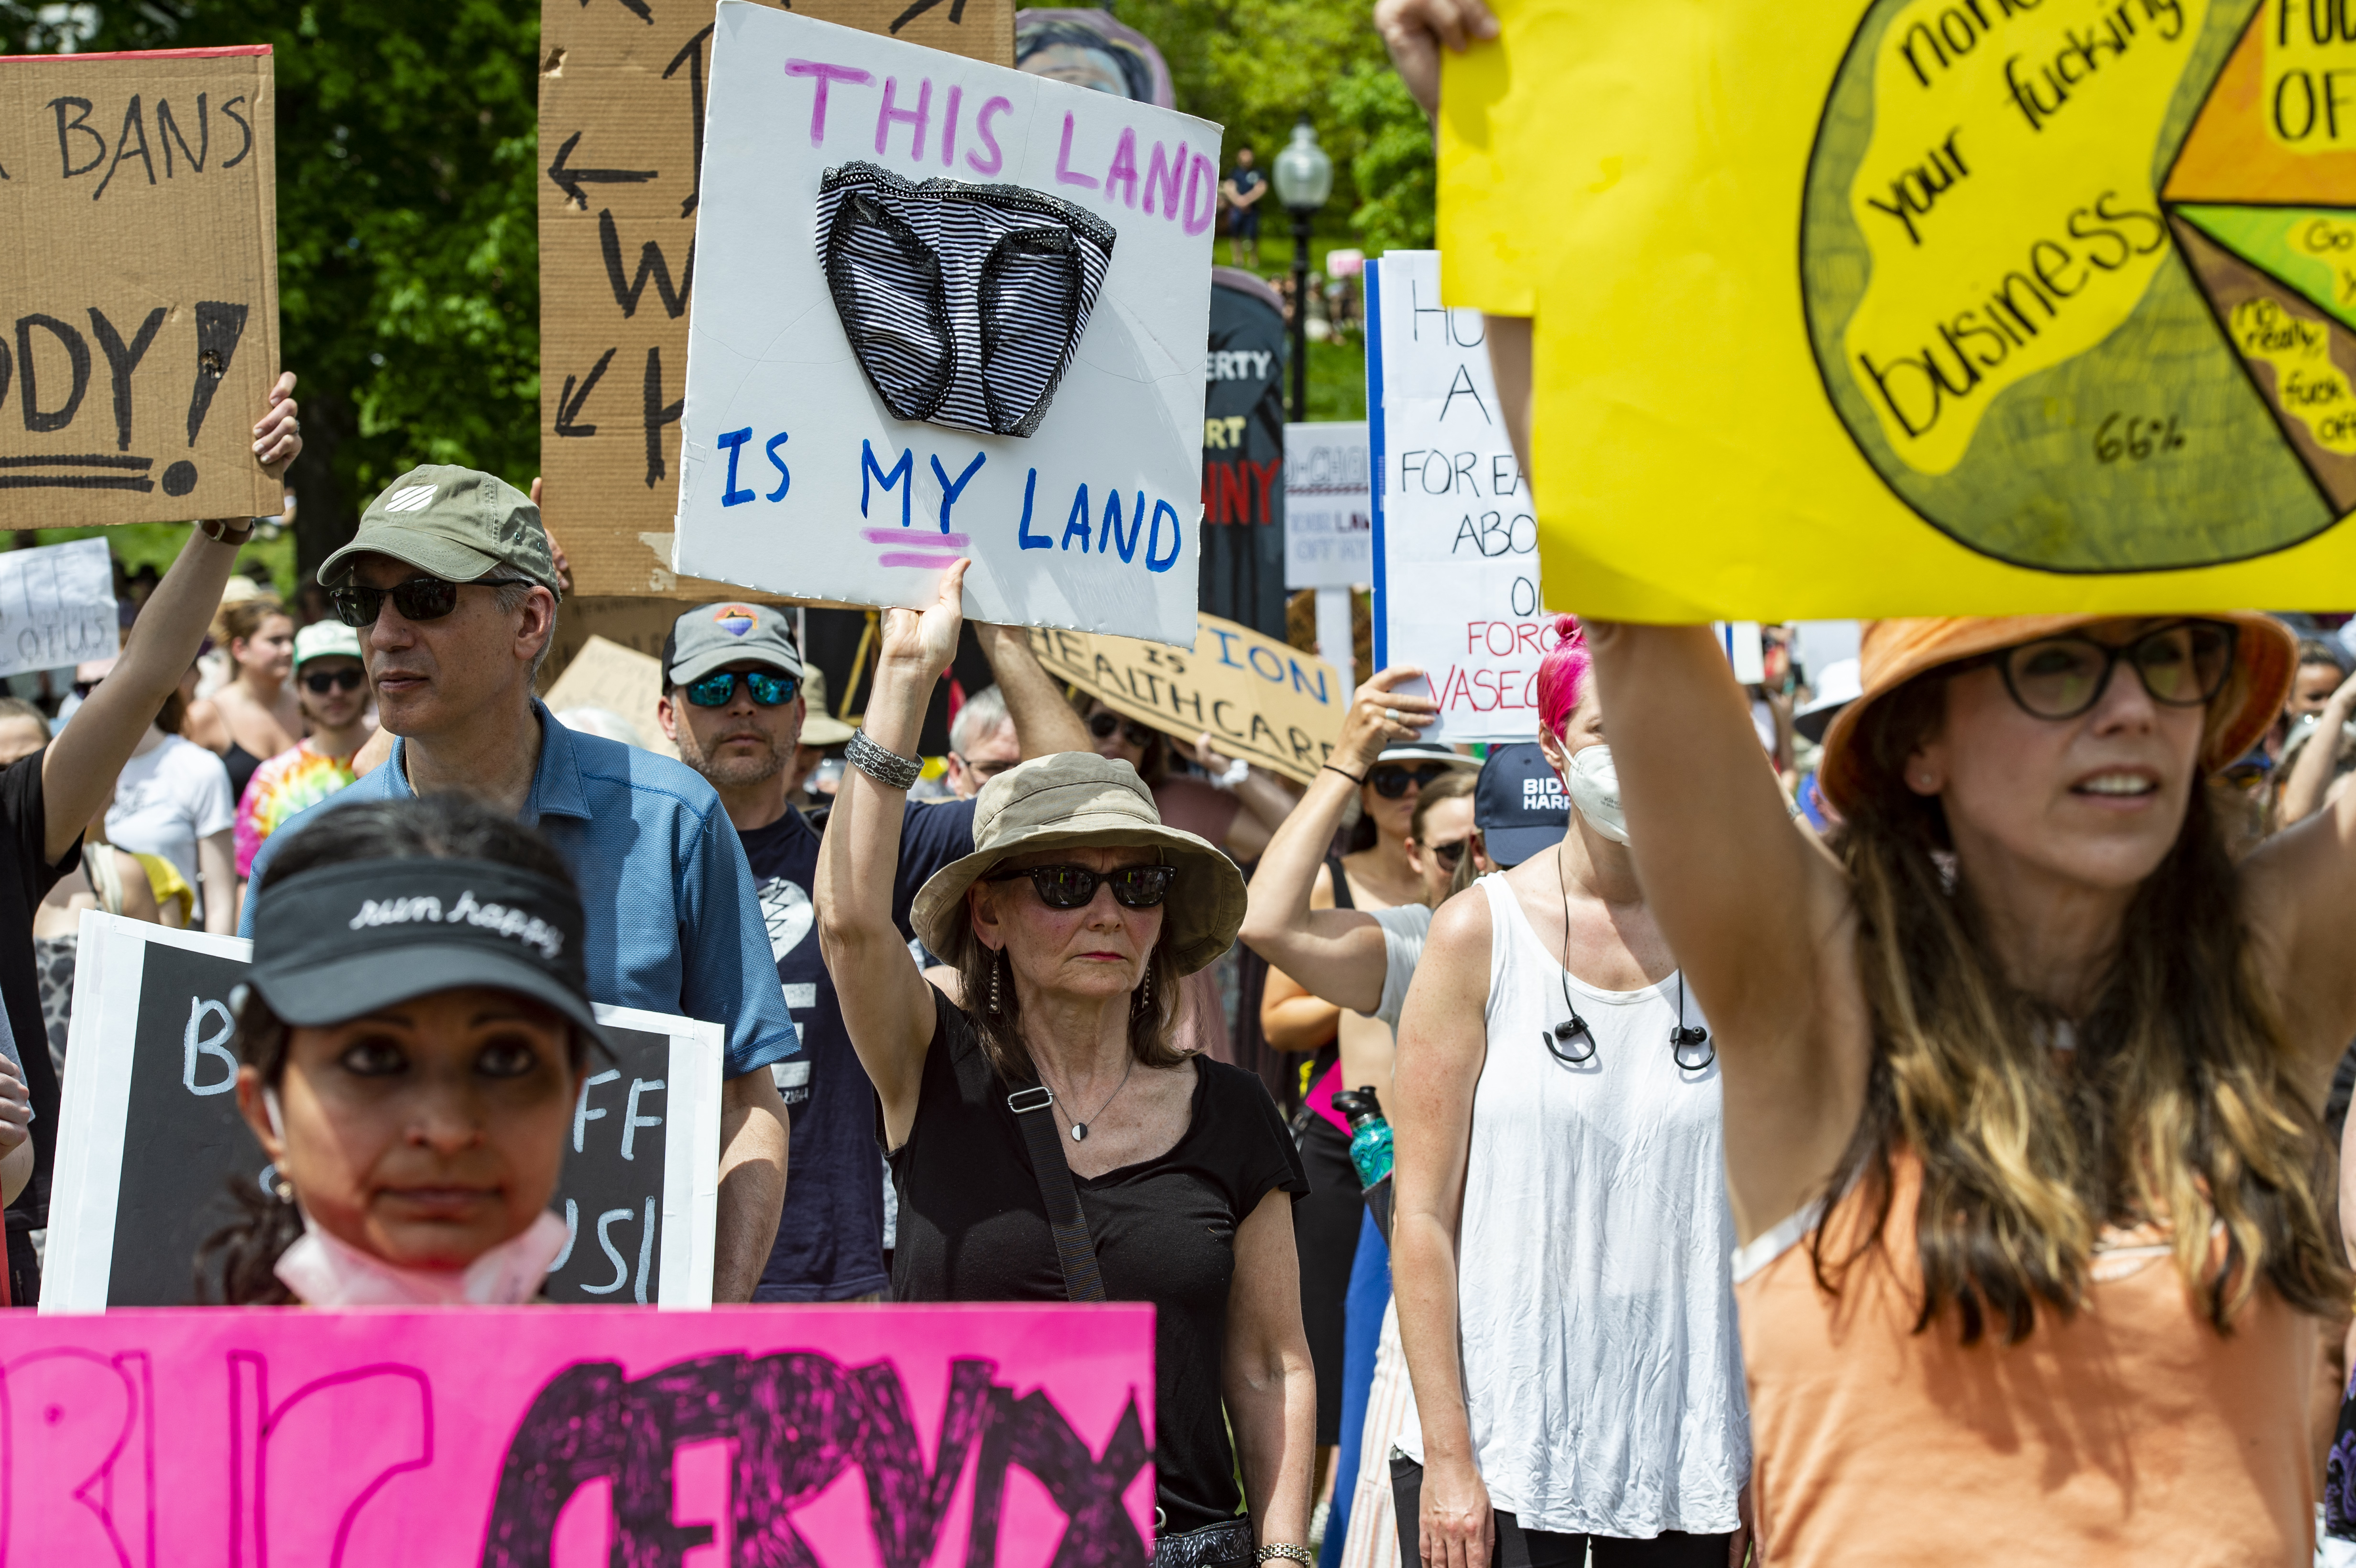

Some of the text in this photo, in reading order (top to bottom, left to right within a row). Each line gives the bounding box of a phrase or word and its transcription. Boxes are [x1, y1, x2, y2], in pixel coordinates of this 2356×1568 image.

[2274, 68, 2356, 141] OF
[44, 92, 251, 201] BANS
[785, 57, 1216, 237] THIS LAND
[1867, 124, 1970, 247] your
[599, 208, 696, 319] W
[1412, 279, 1486, 348] HO
[1858, 190, 2168, 438] business
[0, 301, 249, 496] DY!
[1439, 364, 1492, 425] A
[2092, 410, 2187, 466] 66%
[717, 426, 1182, 572] IS MY LAND
[1402, 448, 1481, 498] FOR
[1493, 454, 1526, 496] E
[1452, 511, 1538, 557] ABO
[17, 615, 107, 664] OTUS
[1144, 645, 1186, 674] IS
[1188, 623, 1330, 705] ION
[1468, 621, 1555, 656] FORC
[1425, 664, 1538, 714] VASEC
[1523, 777, 1566, 795] BID
[1523, 794, 1571, 810] HARR
[349, 889, 566, 959] run happy
[183, 995, 240, 1096] B
